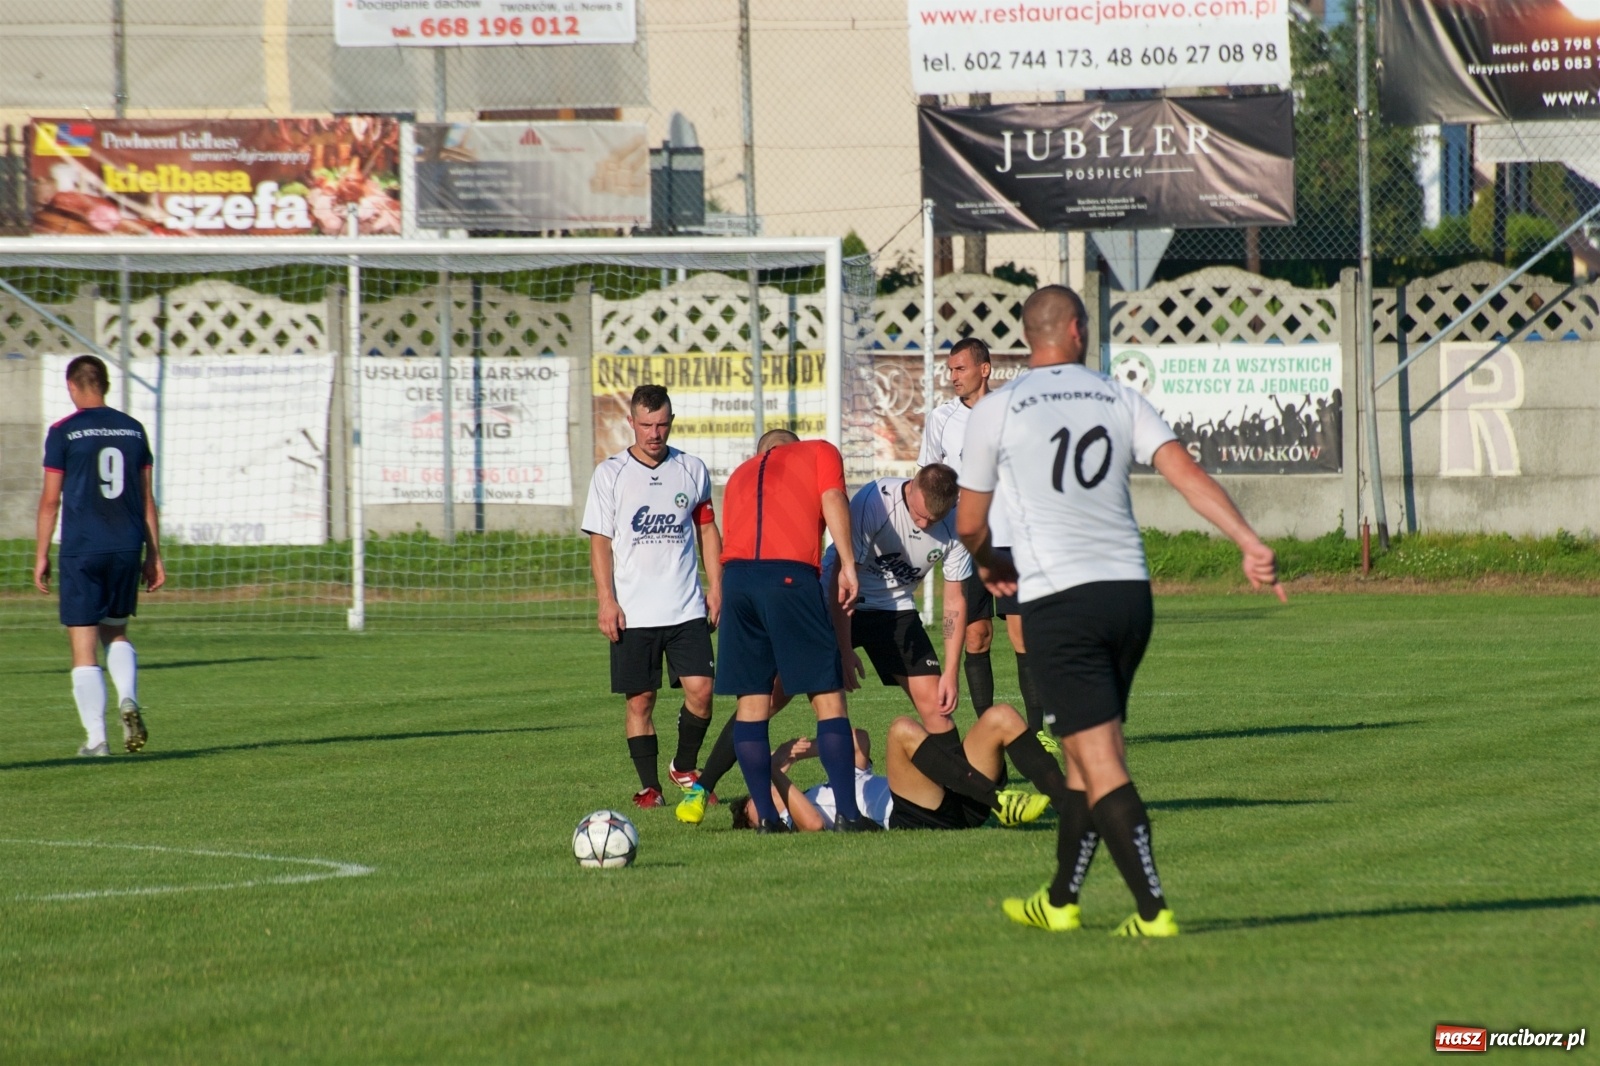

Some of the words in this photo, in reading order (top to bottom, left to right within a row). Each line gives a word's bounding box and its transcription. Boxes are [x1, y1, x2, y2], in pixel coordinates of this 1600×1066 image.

[357, 0, 429, 12] Docieplanie
[582, 2, 613, 12] Nowa
[615, 2, 623, 11] 8
[920, 0, 1277, 25] www.restauracjabravo.com.pl
[420, 17, 469, 38] 668
[478, 17, 524, 37] 196
[531, 16, 581, 36] 012
[1492, 42, 1528, 55] Karol:
[1531, 38, 1560, 53] 603
[1563, 36, 1592, 51] 798
[922, 53, 955, 72] tel.
[963, 52, 1001, 71] 602
[1009, 50, 1047, 69] 744
[1055, 49, 1099, 69] 173,
[1107, 48, 1133, 67] 48
[1140, 47, 1178, 66] 606
[1186, 46, 1210, 64] 27
[1218, 44, 1244, 63] 08
[1252, 43, 1278, 62] 98
[1468, 59, 1529, 76] Krzysztof:
[1532, 57, 1560, 72] 605
[1564, 55, 1592, 70] 083
[102, 131, 178, 150] Producent
[102, 164, 252, 193] kiełbasa
[1065, 166, 1143, 181] POŚPIECH
[166, 181, 312, 230] szefa
[365, 366, 438, 380] USŁUGI
[1159, 358, 1207, 373] JEDEN
[1212, 358, 1231, 373] ZA
[1236, 357, 1332, 372] WSZYSTKICH
[406, 387, 520, 402] CIESELSKIE
[1162, 378, 1231, 394] WSZYSCY
[1237, 378, 1255, 394] ZA
[1260, 377, 1329, 394] JEDNEGO
[711, 398, 778, 412] Producnt
[1011, 396, 1038, 414] LKS
[1440, 342, 1524, 476] R
[460, 422, 511, 439] MIG
[1050, 425, 1112, 494] 10
[1218, 440, 1321, 463] TWORKÓW
[98, 446, 124, 500] 9
[507, 467, 543, 483] 012
[485, 487, 522, 499] Nowa
[528, 487, 536, 499] 8
